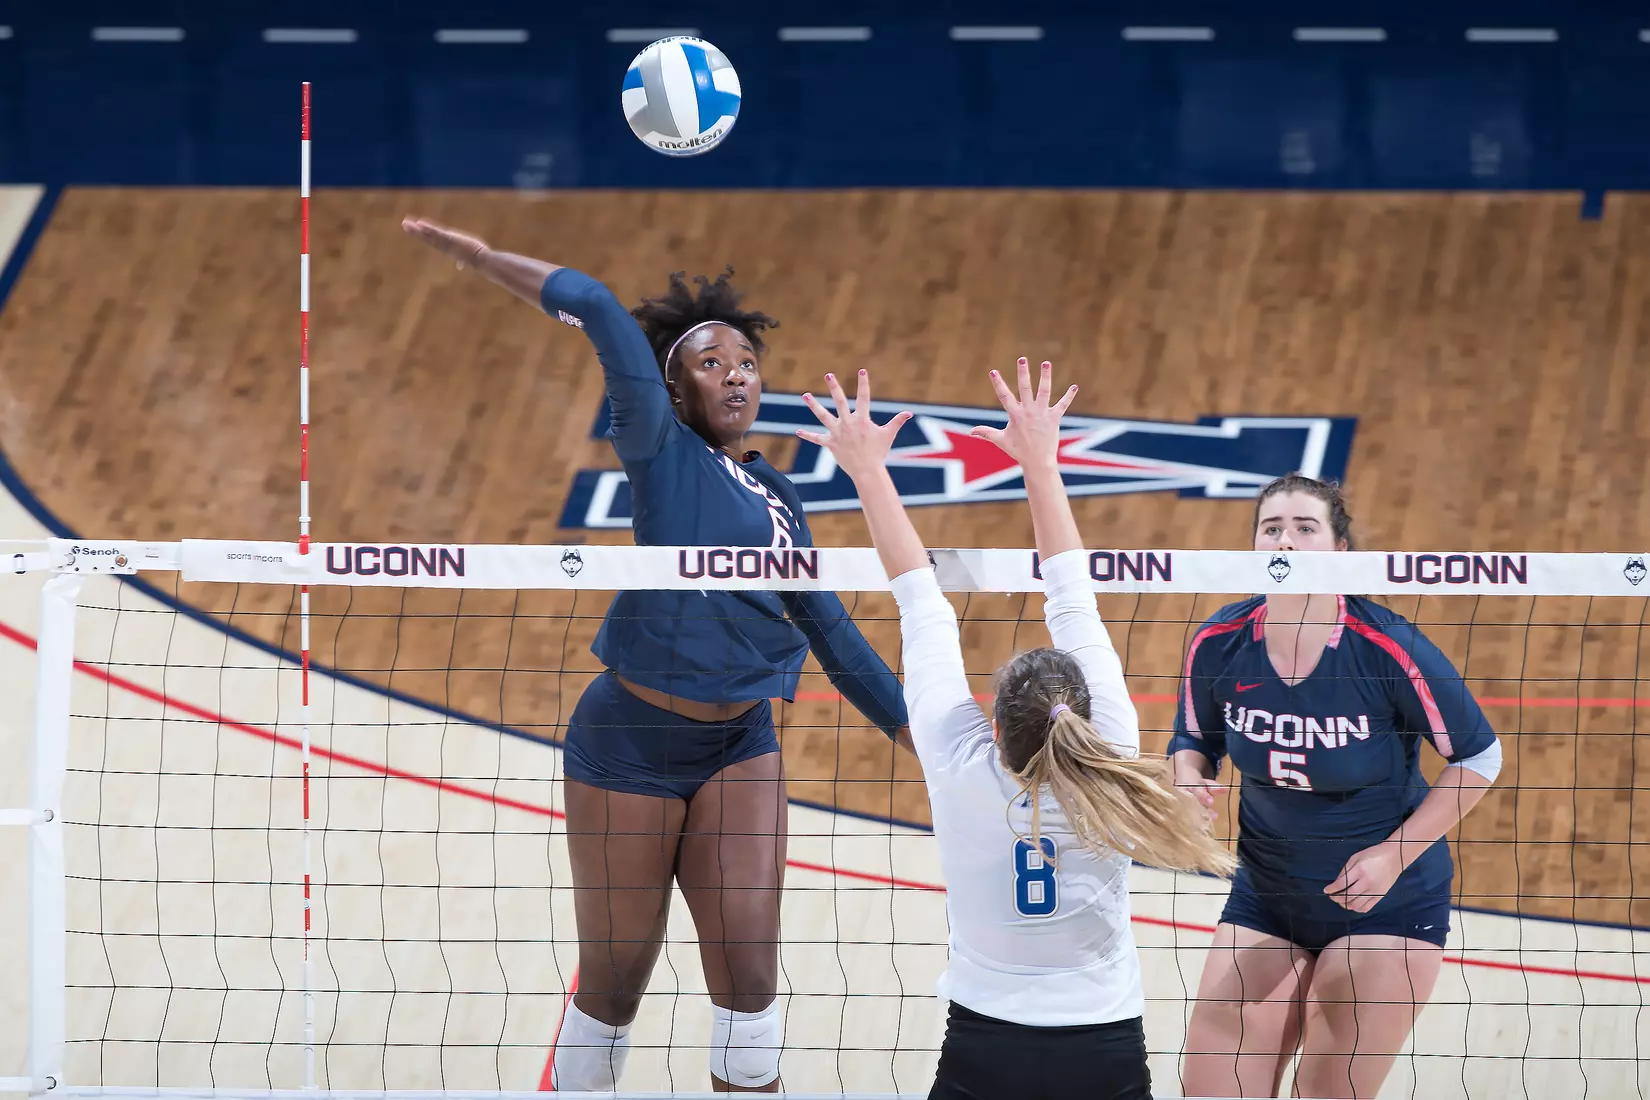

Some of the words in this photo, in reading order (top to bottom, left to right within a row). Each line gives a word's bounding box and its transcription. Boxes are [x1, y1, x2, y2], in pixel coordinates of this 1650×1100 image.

[658, 128, 722, 149] molten
[81, 547, 120, 556] Senoh
[326, 546, 466, 577] UCONN
[679, 548, 819, 580] UCONN
[1386, 554, 1528, 585] UCONN
[1223, 701, 1371, 750] UCONN
[1268, 749, 1314, 792] 5
[1011, 834, 1061, 919] 8
